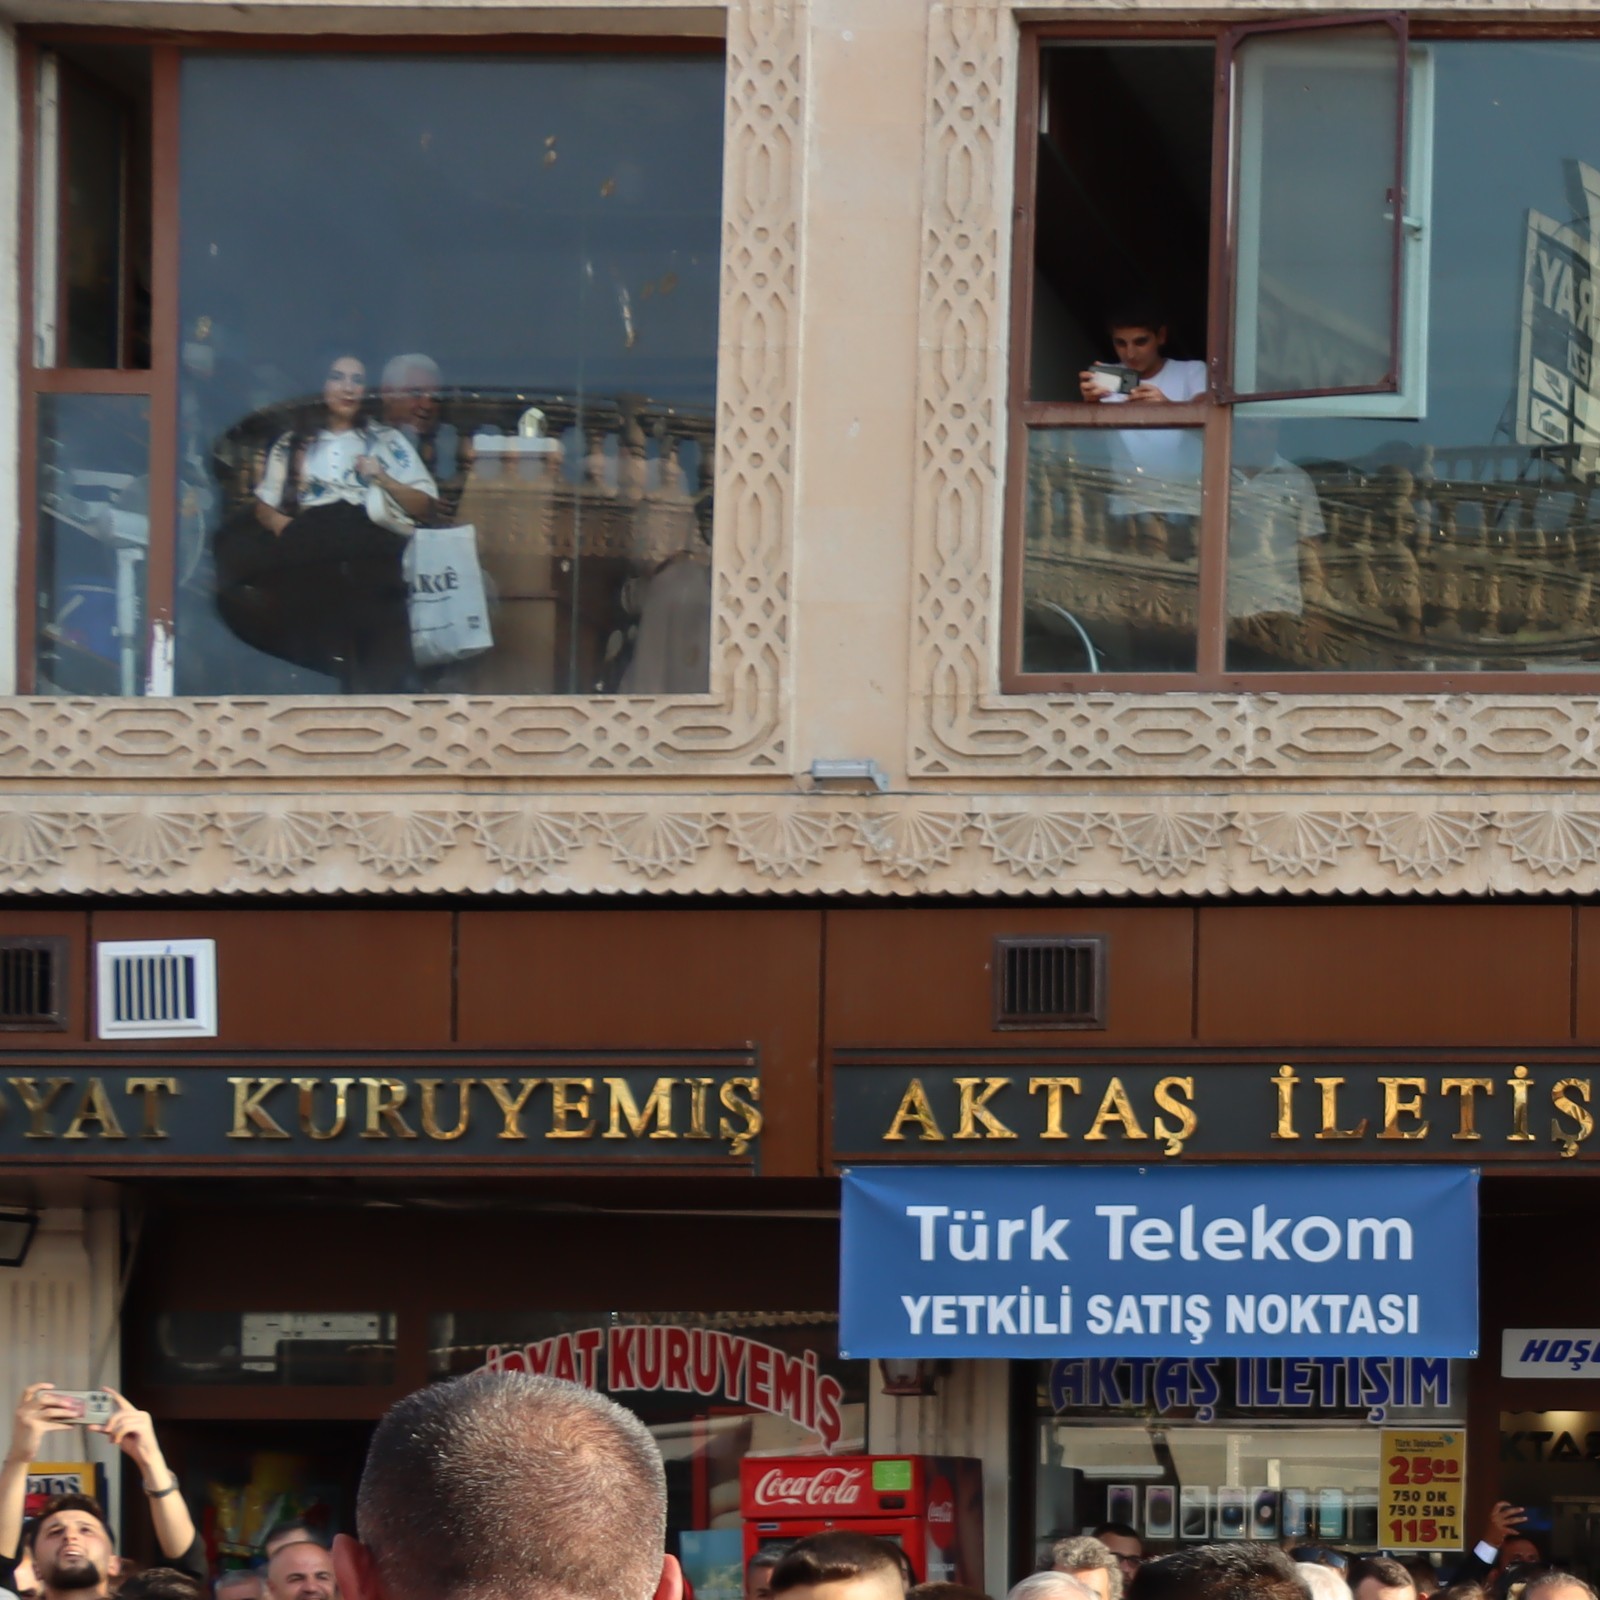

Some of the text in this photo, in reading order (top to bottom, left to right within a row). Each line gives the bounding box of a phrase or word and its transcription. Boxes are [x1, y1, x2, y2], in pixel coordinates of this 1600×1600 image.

[6, 1077, 178, 1140] YAT
[882, 1076, 1198, 1156] AKTAŞ
[906, 1204, 1414, 1263] Türk Telekom
[901, 1286, 1420, 1344] YETKİLİ SATIŞ NOKTASI
[608, 1325, 844, 1456] KURUYEMİŞ
[1389, 1505, 1456, 1517] 750 SMS
[1393, 1490, 1447, 1502] 750 DK
